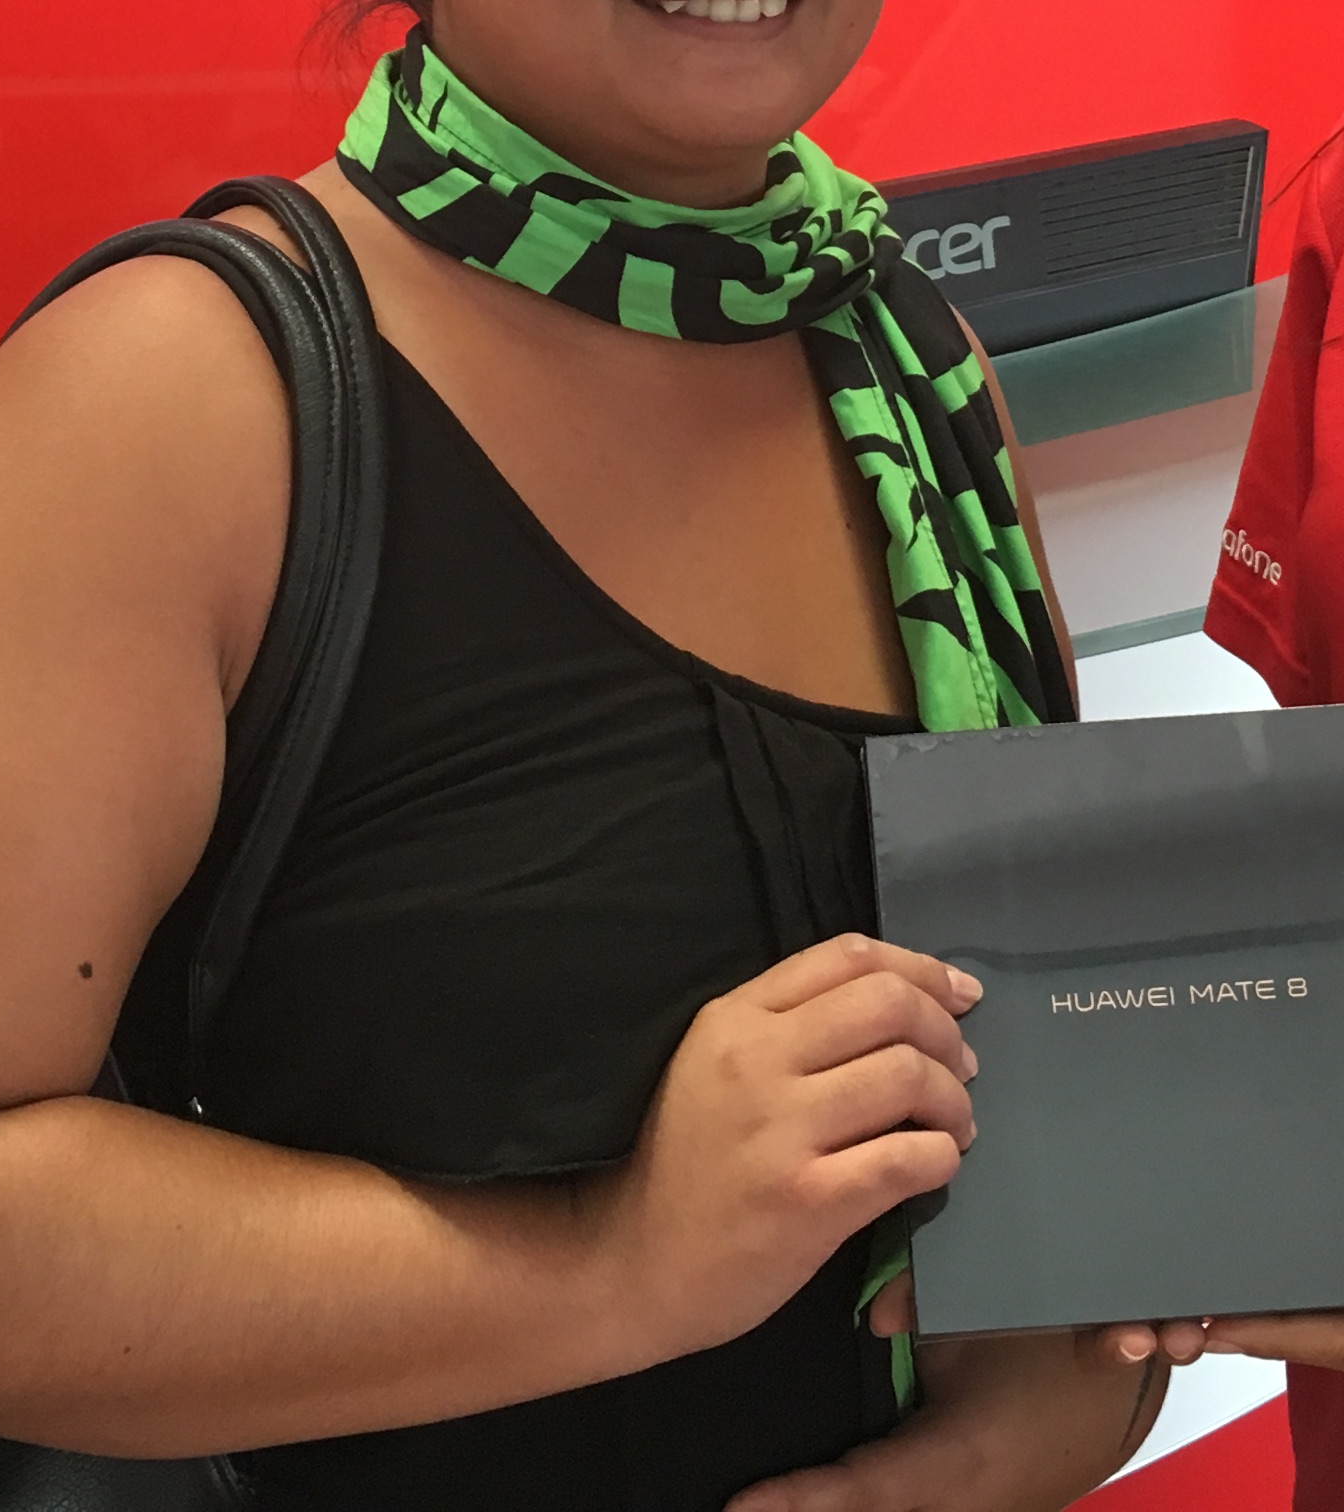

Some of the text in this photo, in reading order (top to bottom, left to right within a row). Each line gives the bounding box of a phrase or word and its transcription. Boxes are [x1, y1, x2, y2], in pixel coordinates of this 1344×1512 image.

[1050, 976, 1309, 1014] HUAWEI MATE 8
